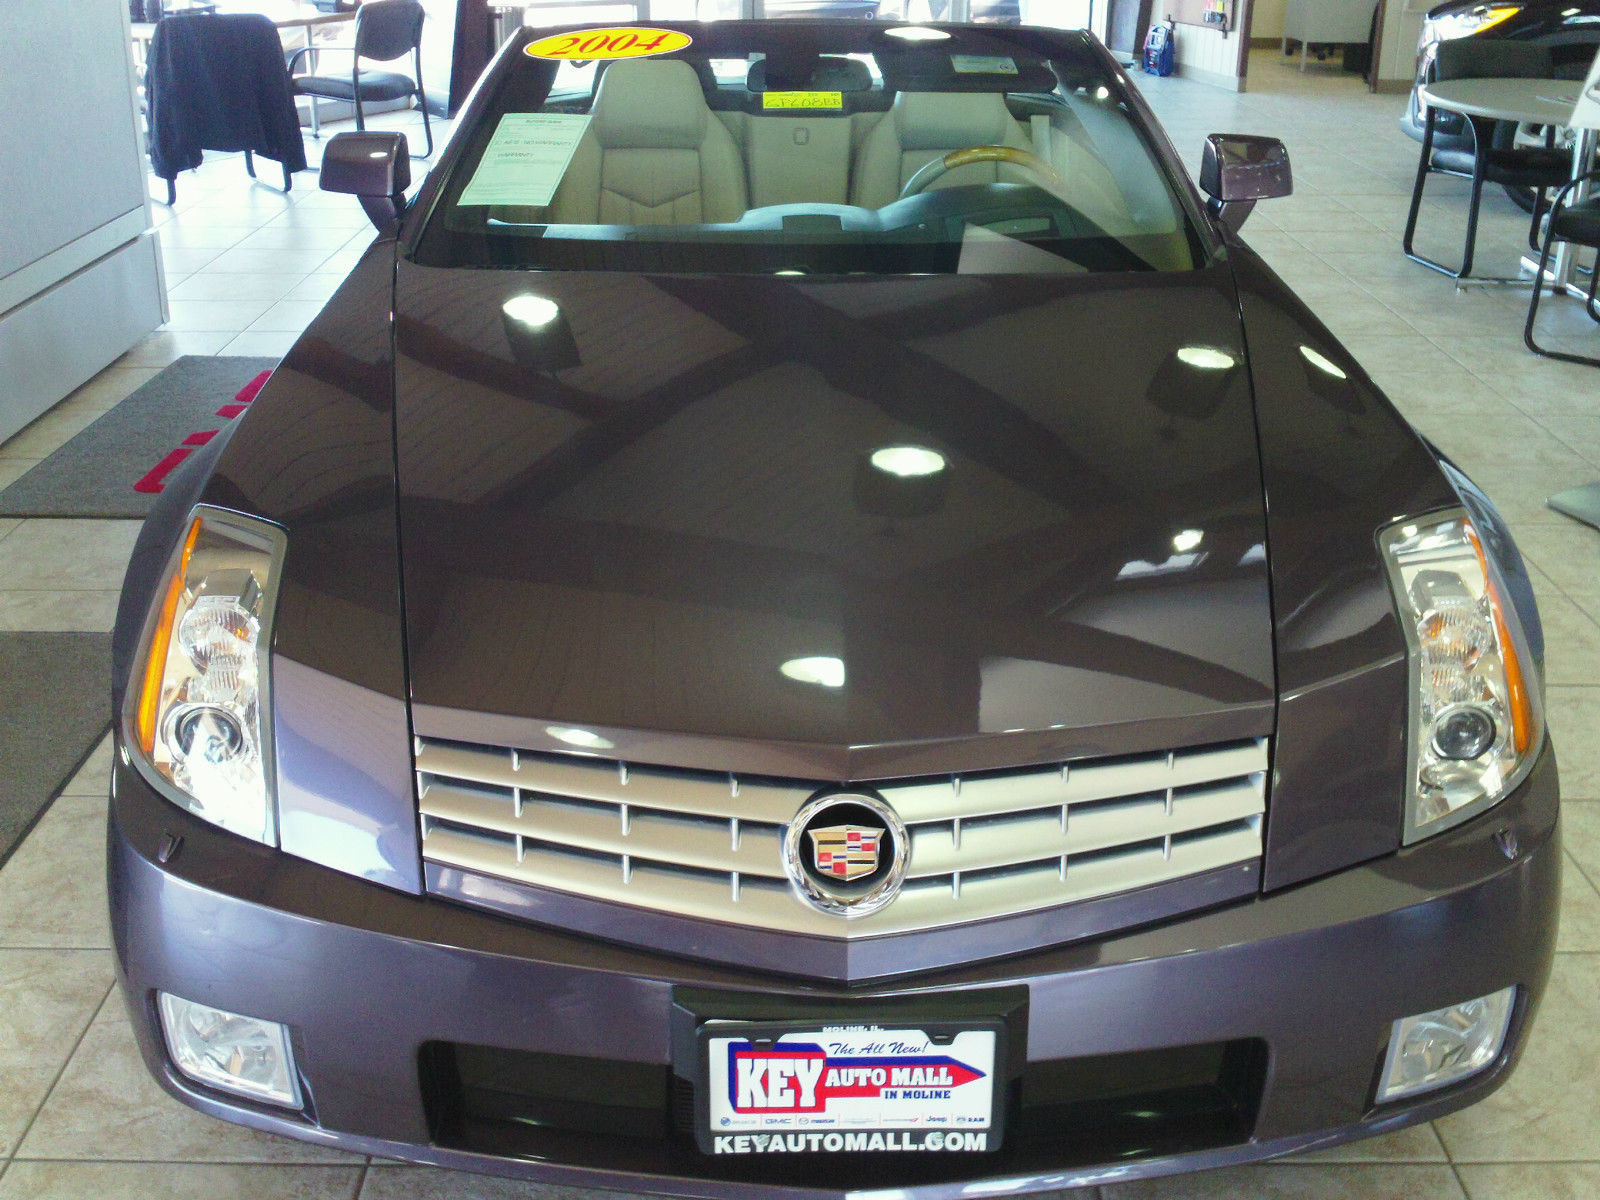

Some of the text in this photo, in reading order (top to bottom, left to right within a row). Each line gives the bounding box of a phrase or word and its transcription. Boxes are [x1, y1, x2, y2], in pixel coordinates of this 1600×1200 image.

[546, 33, 670, 55] 2004
[829, 1040, 931, 1055] The All New!
[736, 1057, 825, 1108] KEY
[825, 1066, 953, 1087] AUTO MALL
[884, 1089, 951, 1100] IN MOLINE
[714, 1131, 987, 1154] KEYAUTOMALL.COM
